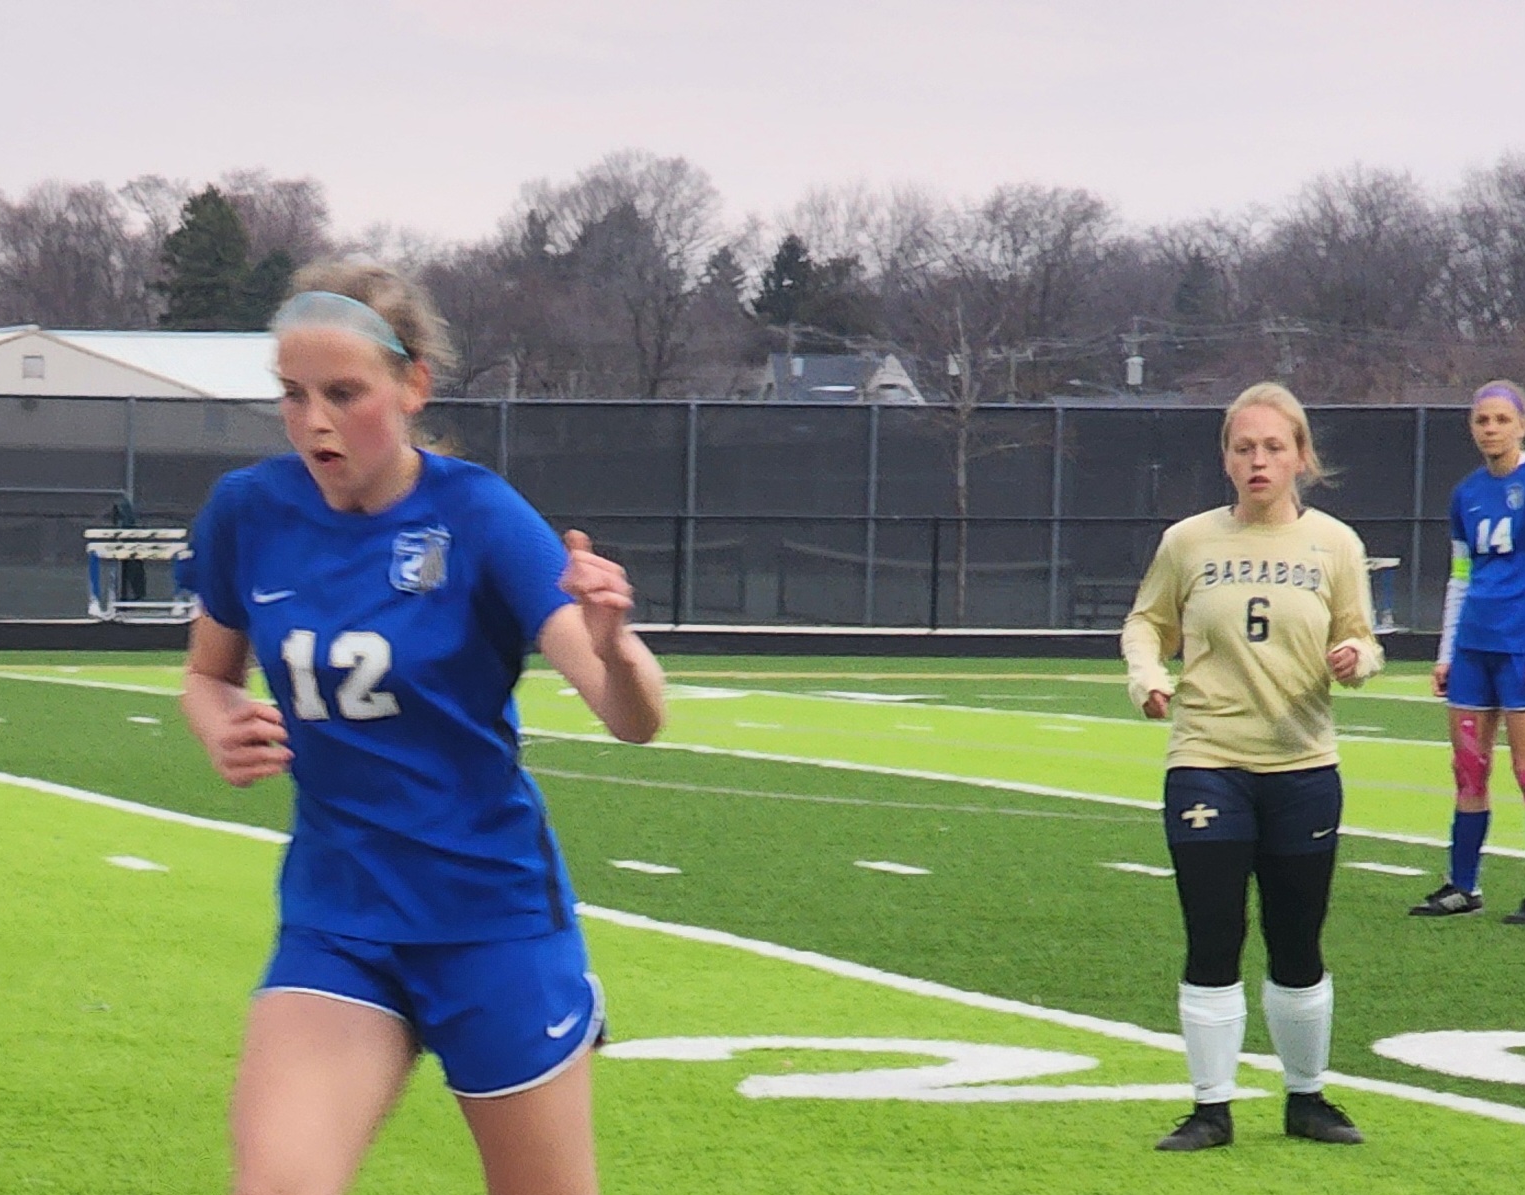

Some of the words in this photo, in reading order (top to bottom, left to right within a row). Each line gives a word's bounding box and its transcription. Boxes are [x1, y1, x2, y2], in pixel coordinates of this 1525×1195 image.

[1477, 516, 1514, 555] 14
[1246, 596, 1271, 642] 6
[281, 629, 402, 720] 12
